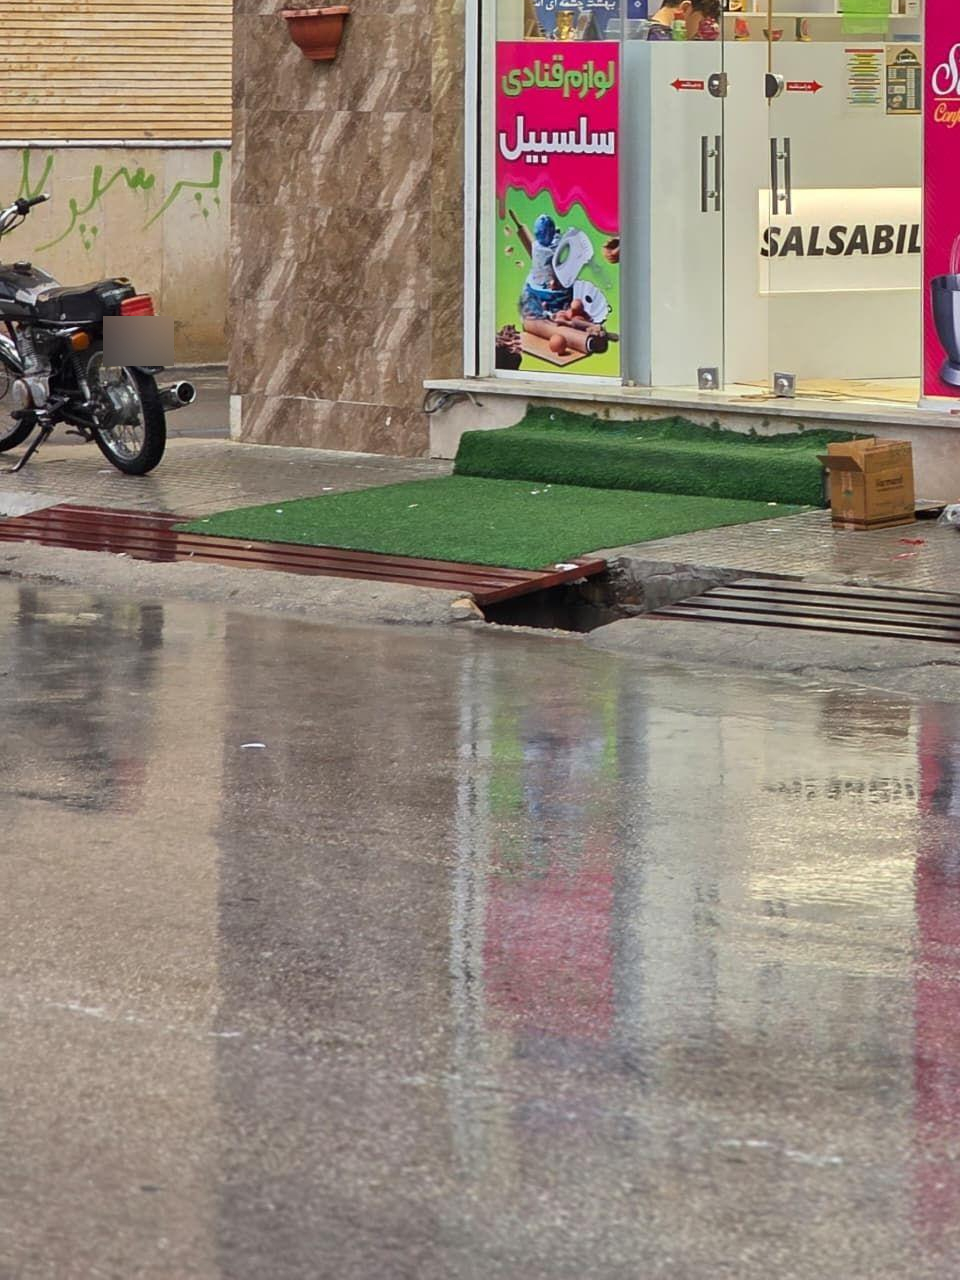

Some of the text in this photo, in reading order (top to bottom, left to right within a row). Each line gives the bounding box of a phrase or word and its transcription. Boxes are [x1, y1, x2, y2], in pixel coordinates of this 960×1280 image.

[502, 54, 615, 99] لوازم قنادی
[499, 115, 615, 163] سلسبیل
[760, 224, 921, 257] SALSABIL
